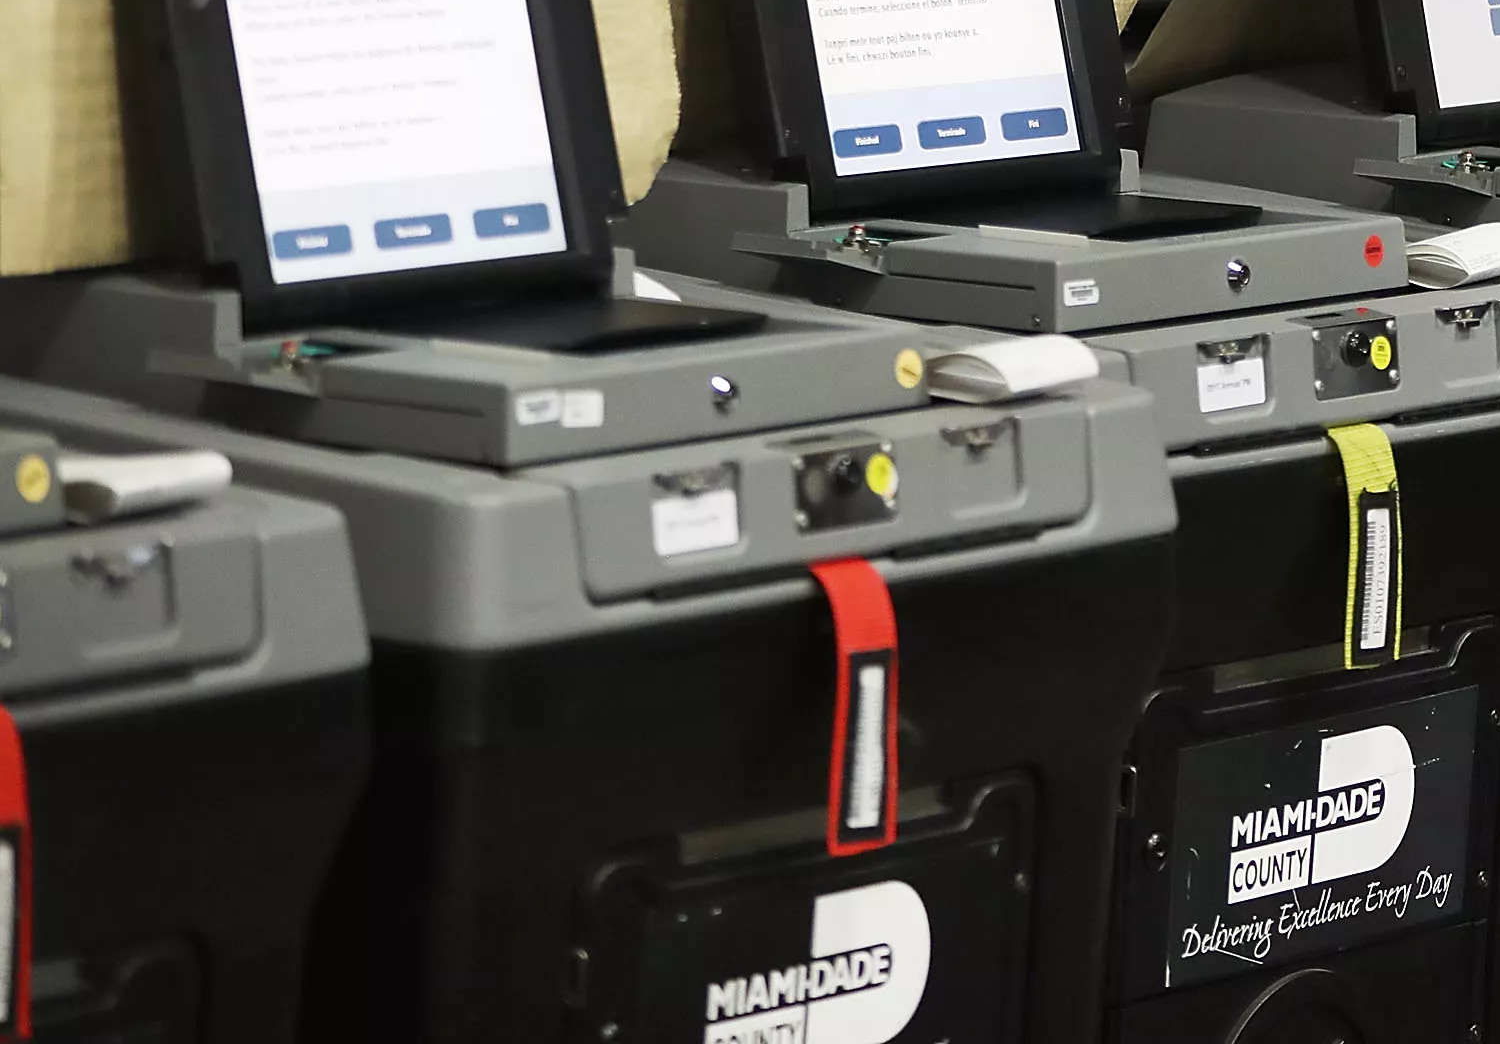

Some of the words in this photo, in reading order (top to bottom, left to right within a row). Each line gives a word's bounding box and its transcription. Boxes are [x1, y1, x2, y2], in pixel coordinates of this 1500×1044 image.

[1231, 781, 1382, 848] MIAMI-DADE
[1232, 847, 1308, 893] COUNTY
[1181, 915, 1273, 964] Delivering
[1278, 888, 1360, 939] Excellence
[1365, 880, 1411, 918] Every
[1415, 865, 1453, 907] Day
[707, 946, 890, 1021] MIAMI-DADE
